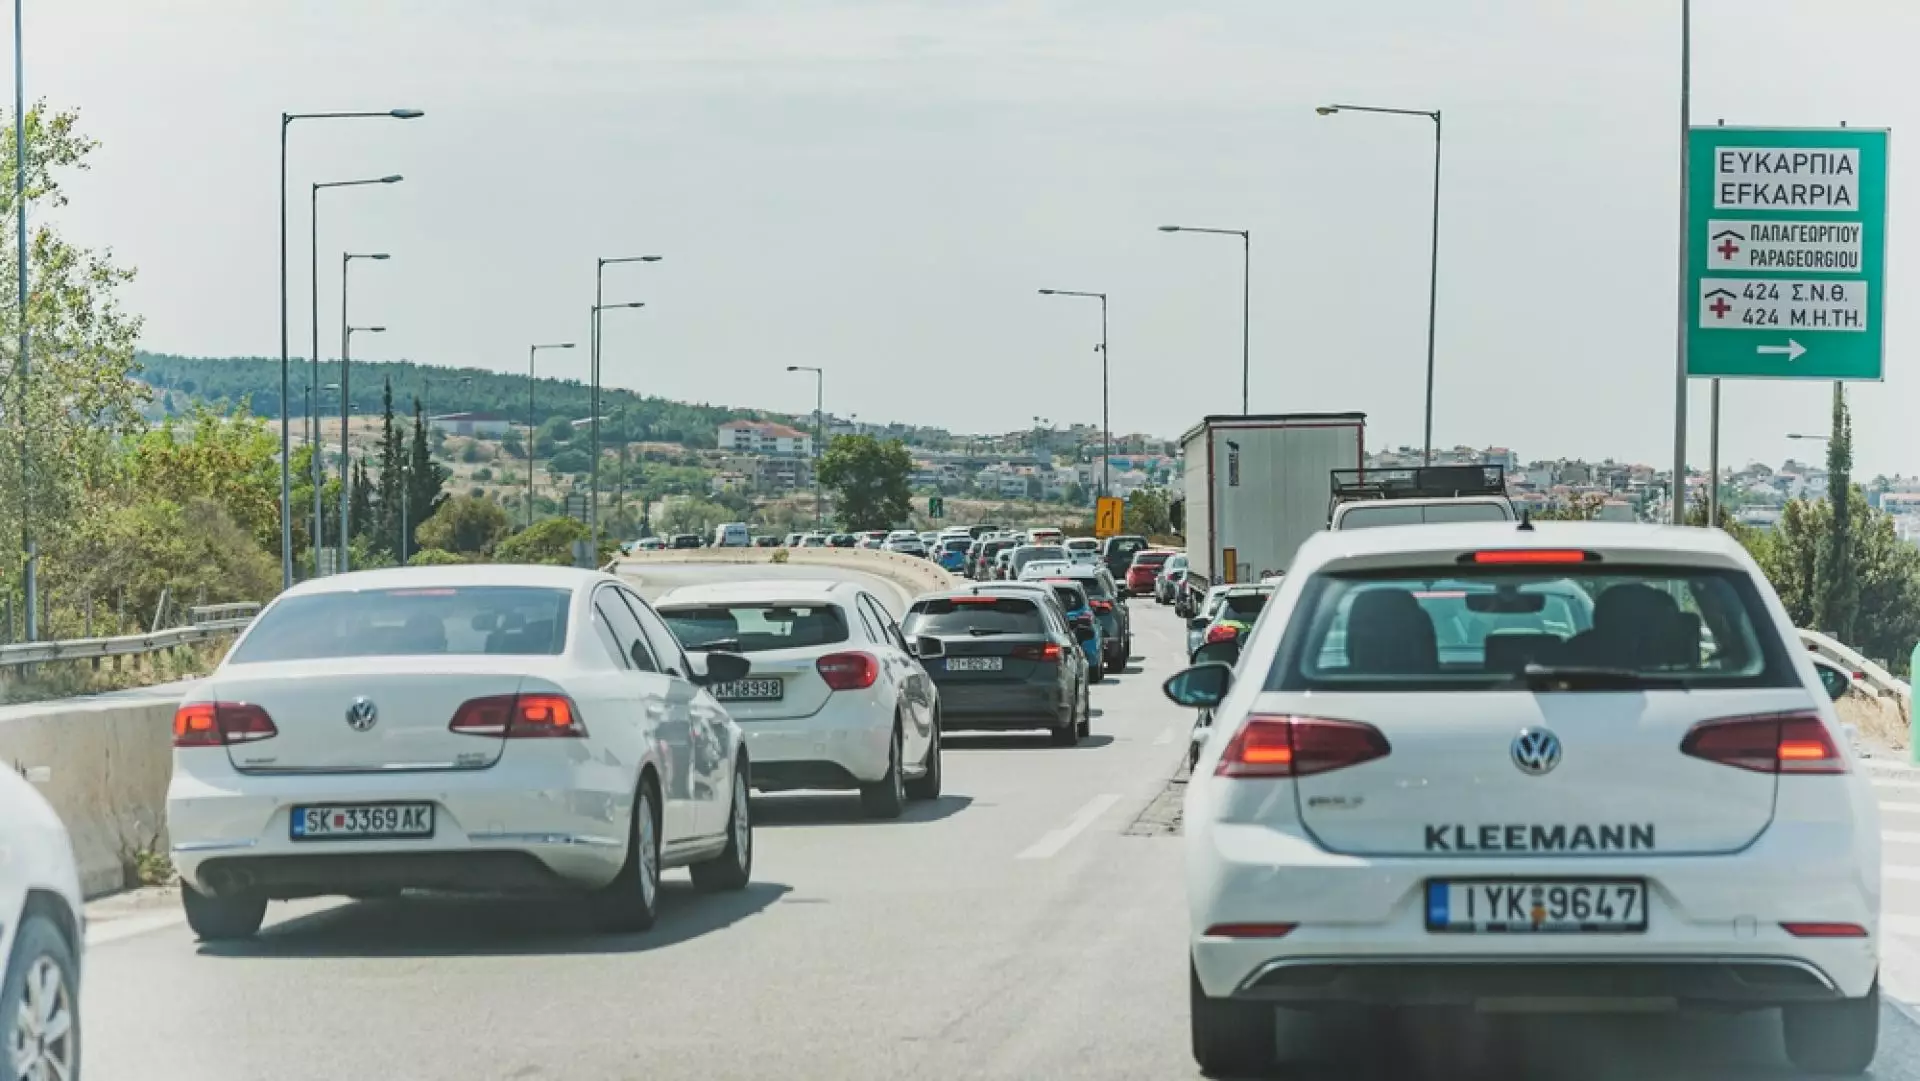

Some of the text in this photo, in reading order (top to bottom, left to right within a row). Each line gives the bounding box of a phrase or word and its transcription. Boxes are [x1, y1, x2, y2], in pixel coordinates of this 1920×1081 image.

[1719, 152, 1854, 175] ΕΥΚΑΡΠΙΑ
[1720, 183, 1851, 205] EFKARPIA
[1750, 224, 1859, 243] ΠΑΠΑΓΕΩΡΓΙΟΥ
[1750, 249, 1858, 268] PAPAGEORGIOU
[1743, 283, 1779, 300] 424
[1742, 308, 1779, 325] 424
[741, 681, 779, 697] 8998
[306, 807, 427, 832] SK 3369 AK
[1425, 823, 1655, 850] KLEEMANN
[1549, 886, 1636, 919] 9647
